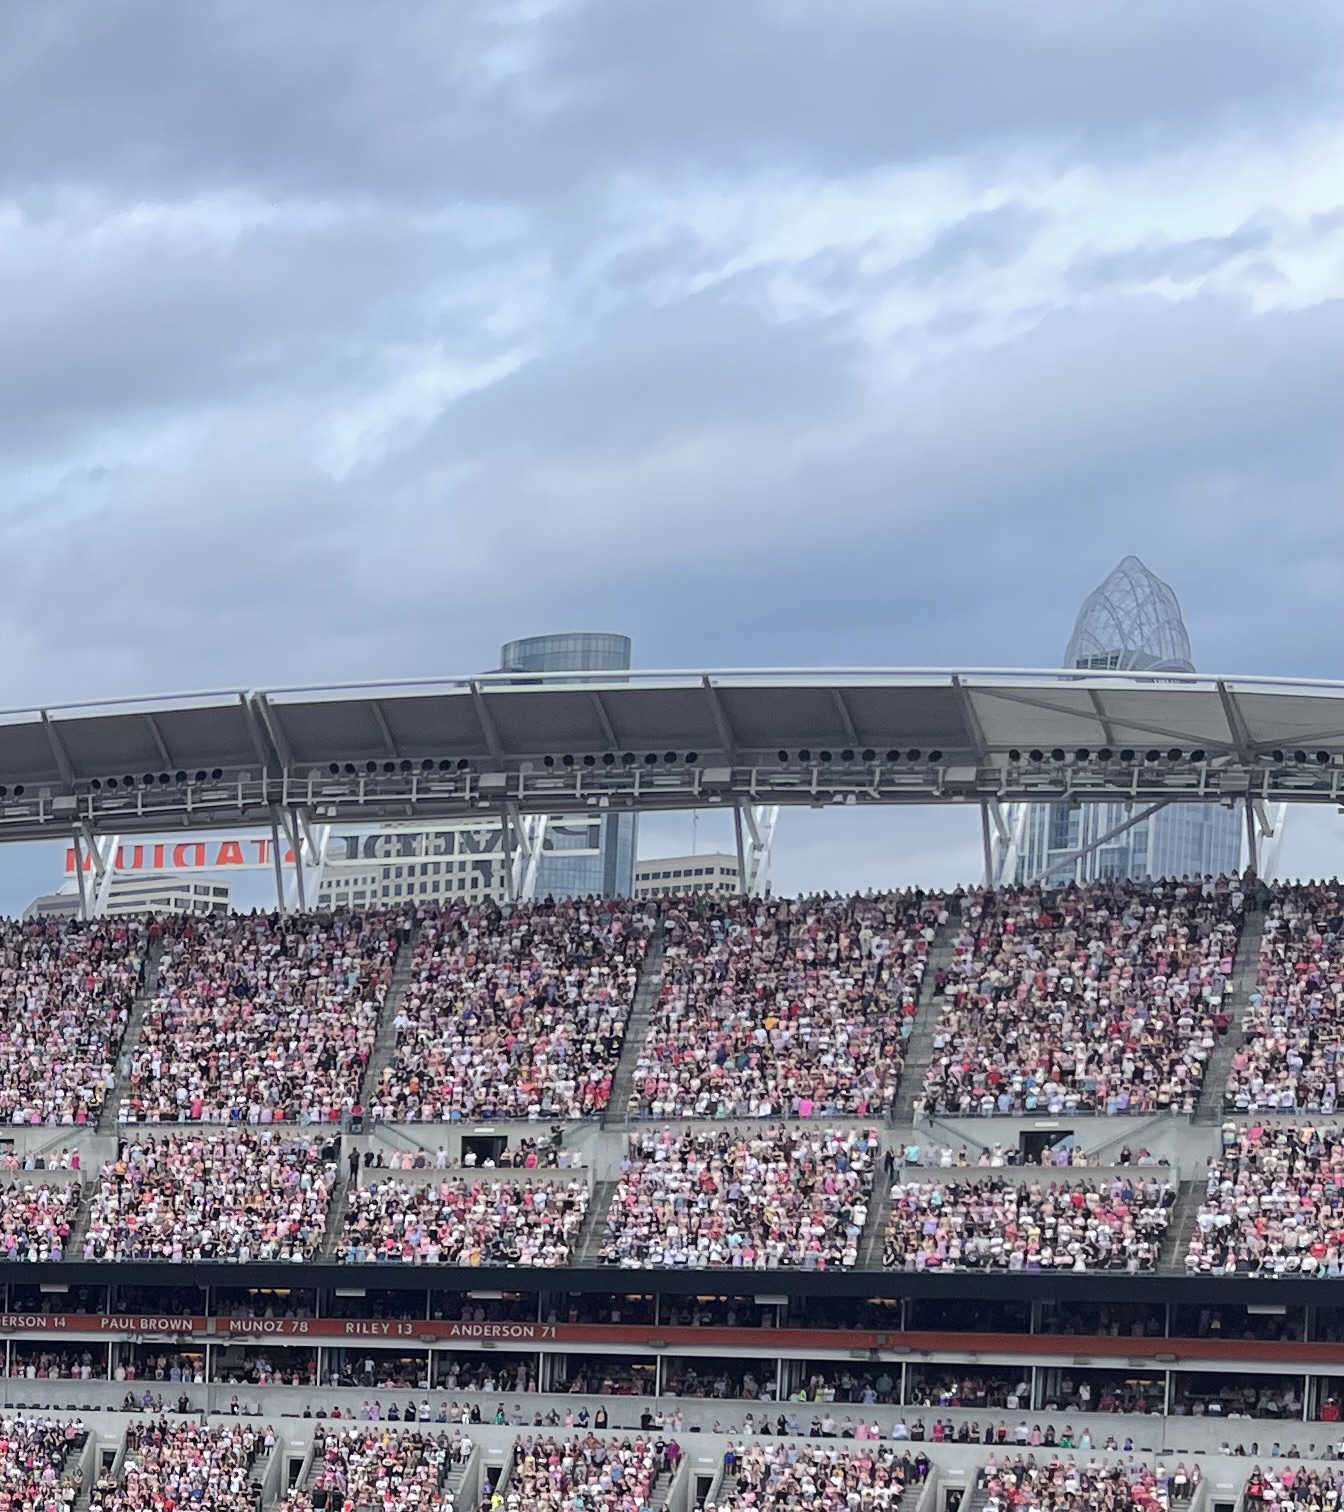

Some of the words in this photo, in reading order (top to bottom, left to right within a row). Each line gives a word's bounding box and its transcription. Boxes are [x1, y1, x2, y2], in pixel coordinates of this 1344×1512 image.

[53, 1317, 66, 1328] 14
[100, 1317, 136, 1329] PAUL
[140, 1318, 193, 1330] BROWN
[229, 1320, 284, 1333] MUNOZ
[291, 1321, 309, 1333] 78
[345, 1322, 391, 1335] RILEY
[397, 1323, 413, 1335] 13
[450, 1324, 534, 1337] ANDERSON
[541, 1326, 556, 1338] 71
